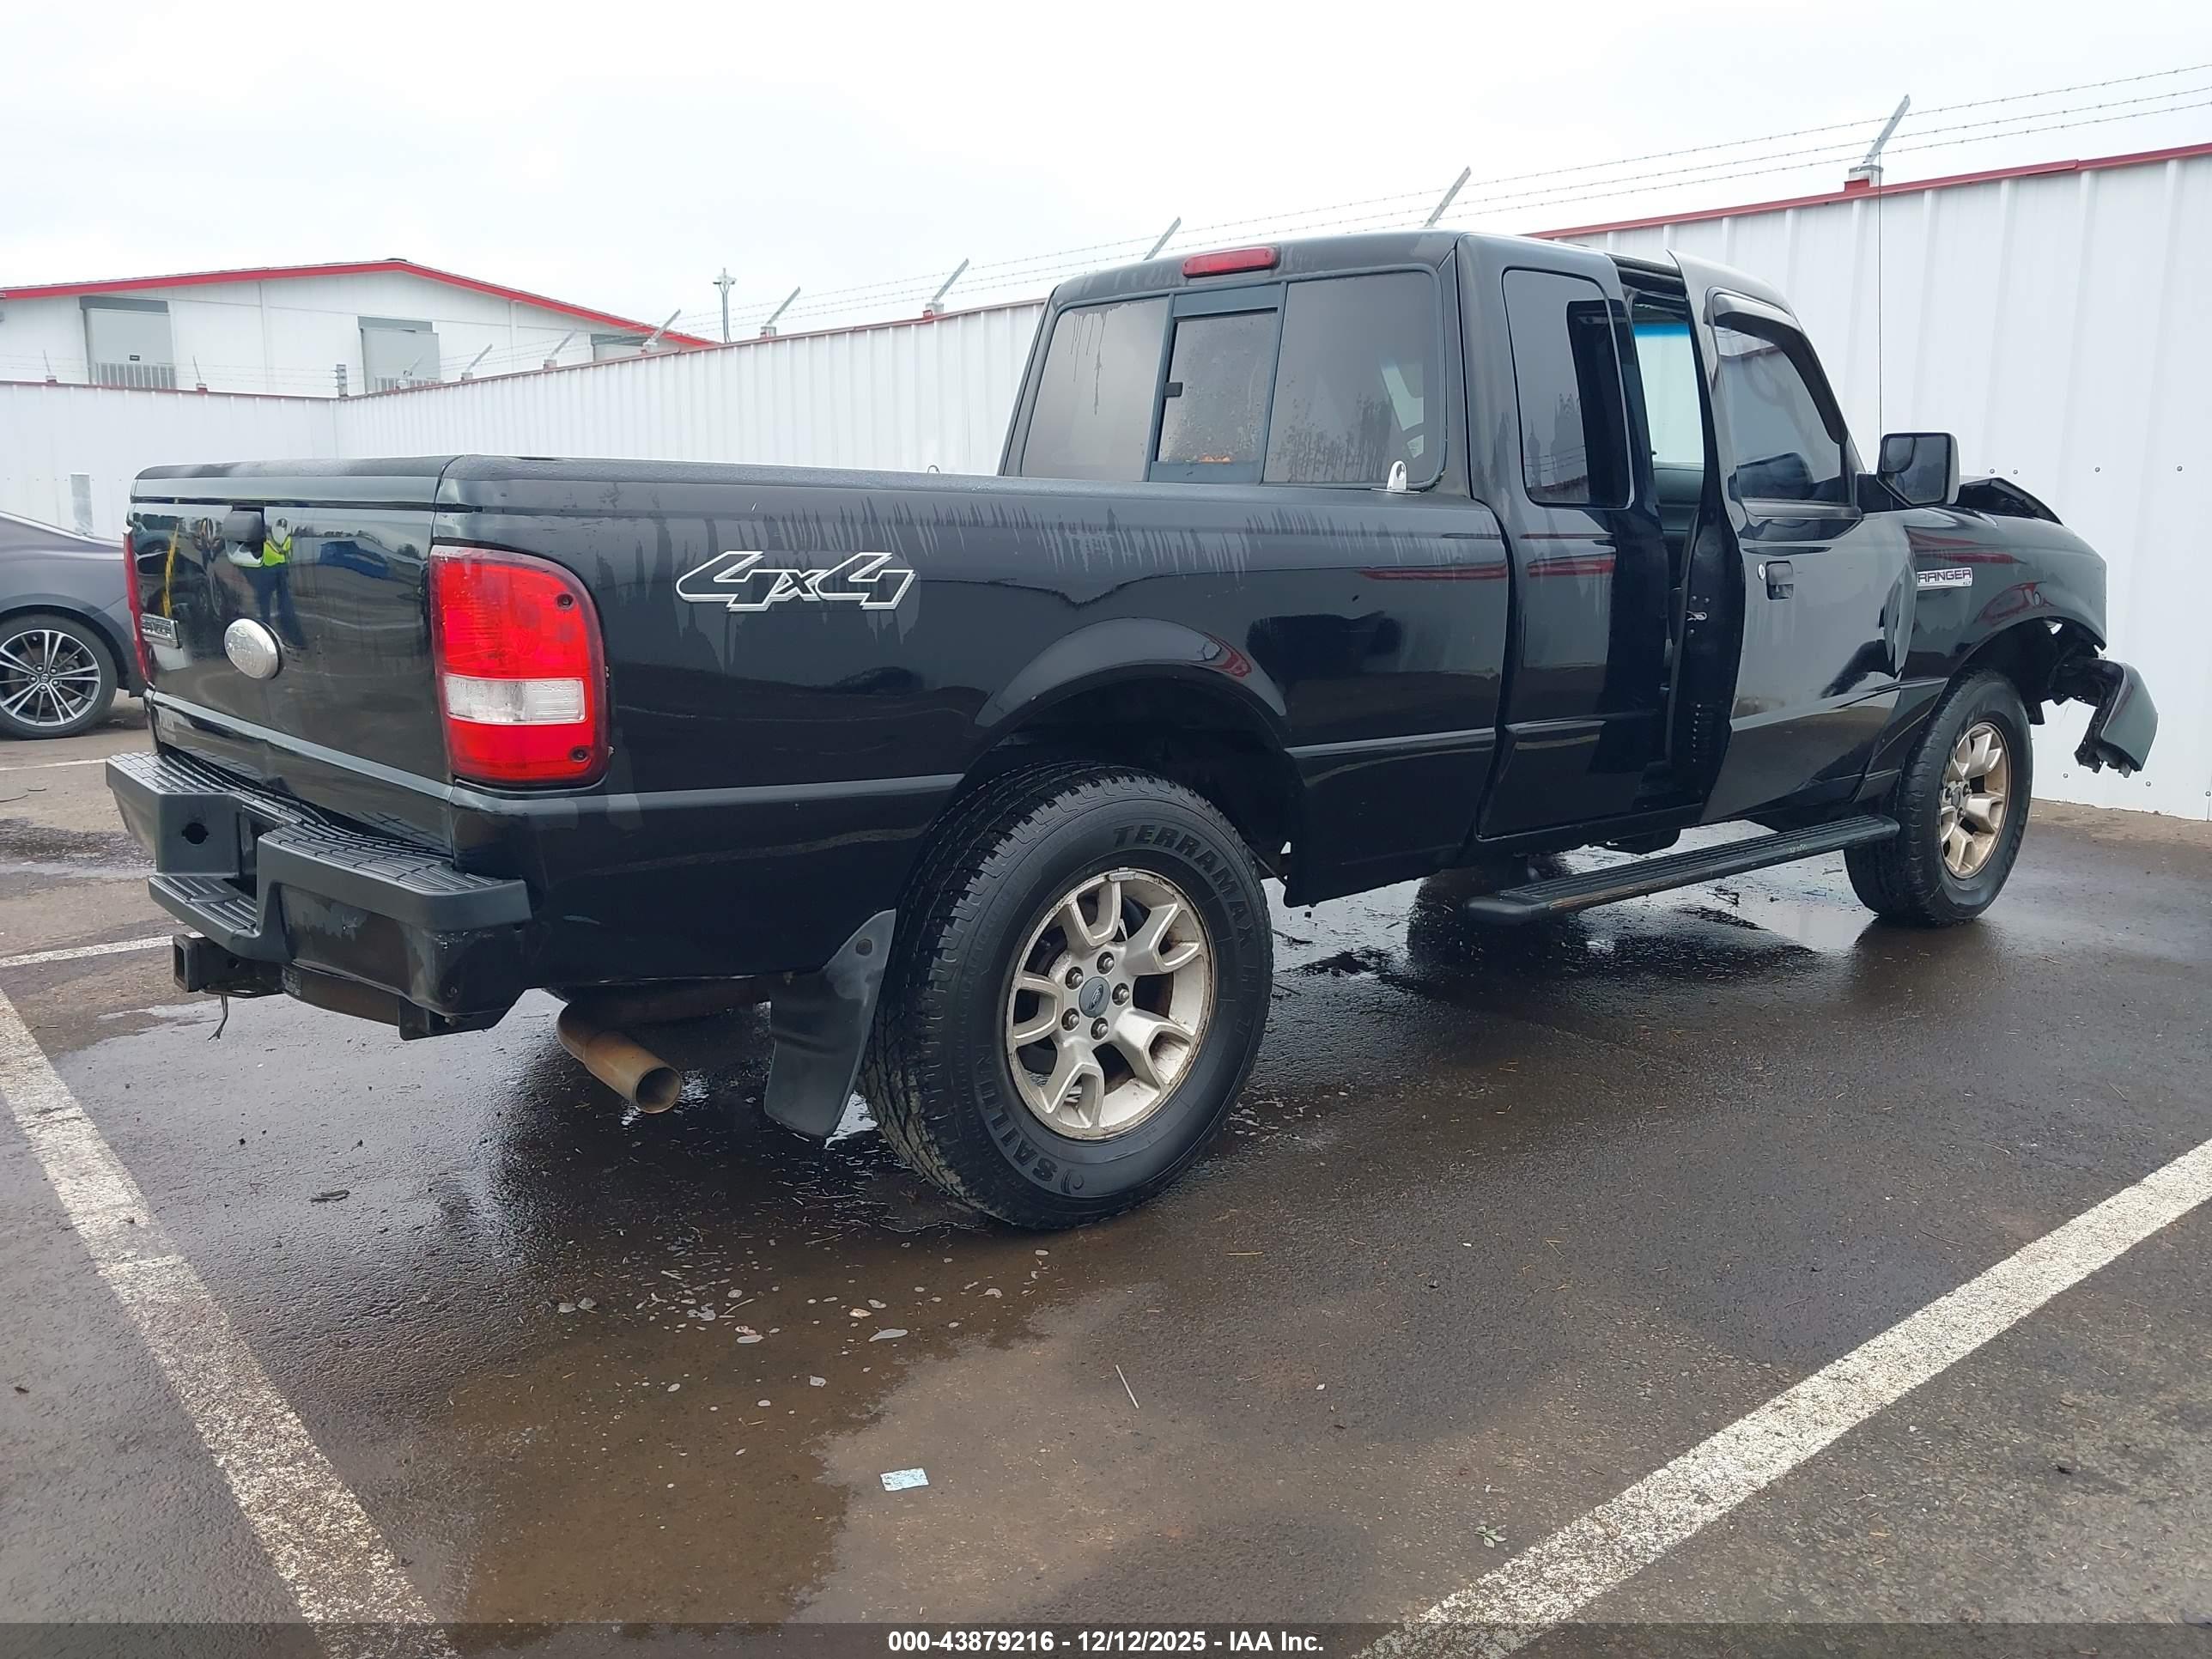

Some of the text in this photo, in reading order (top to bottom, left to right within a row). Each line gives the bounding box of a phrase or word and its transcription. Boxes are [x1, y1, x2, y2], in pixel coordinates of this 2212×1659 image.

[676, 550, 916, 612] 4x4
[1917, 568, 1972, 583] RANGER
[1114, 824, 1252, 949] TERRAMAX
[975, 1044, 1059, 1182] SAILUN
